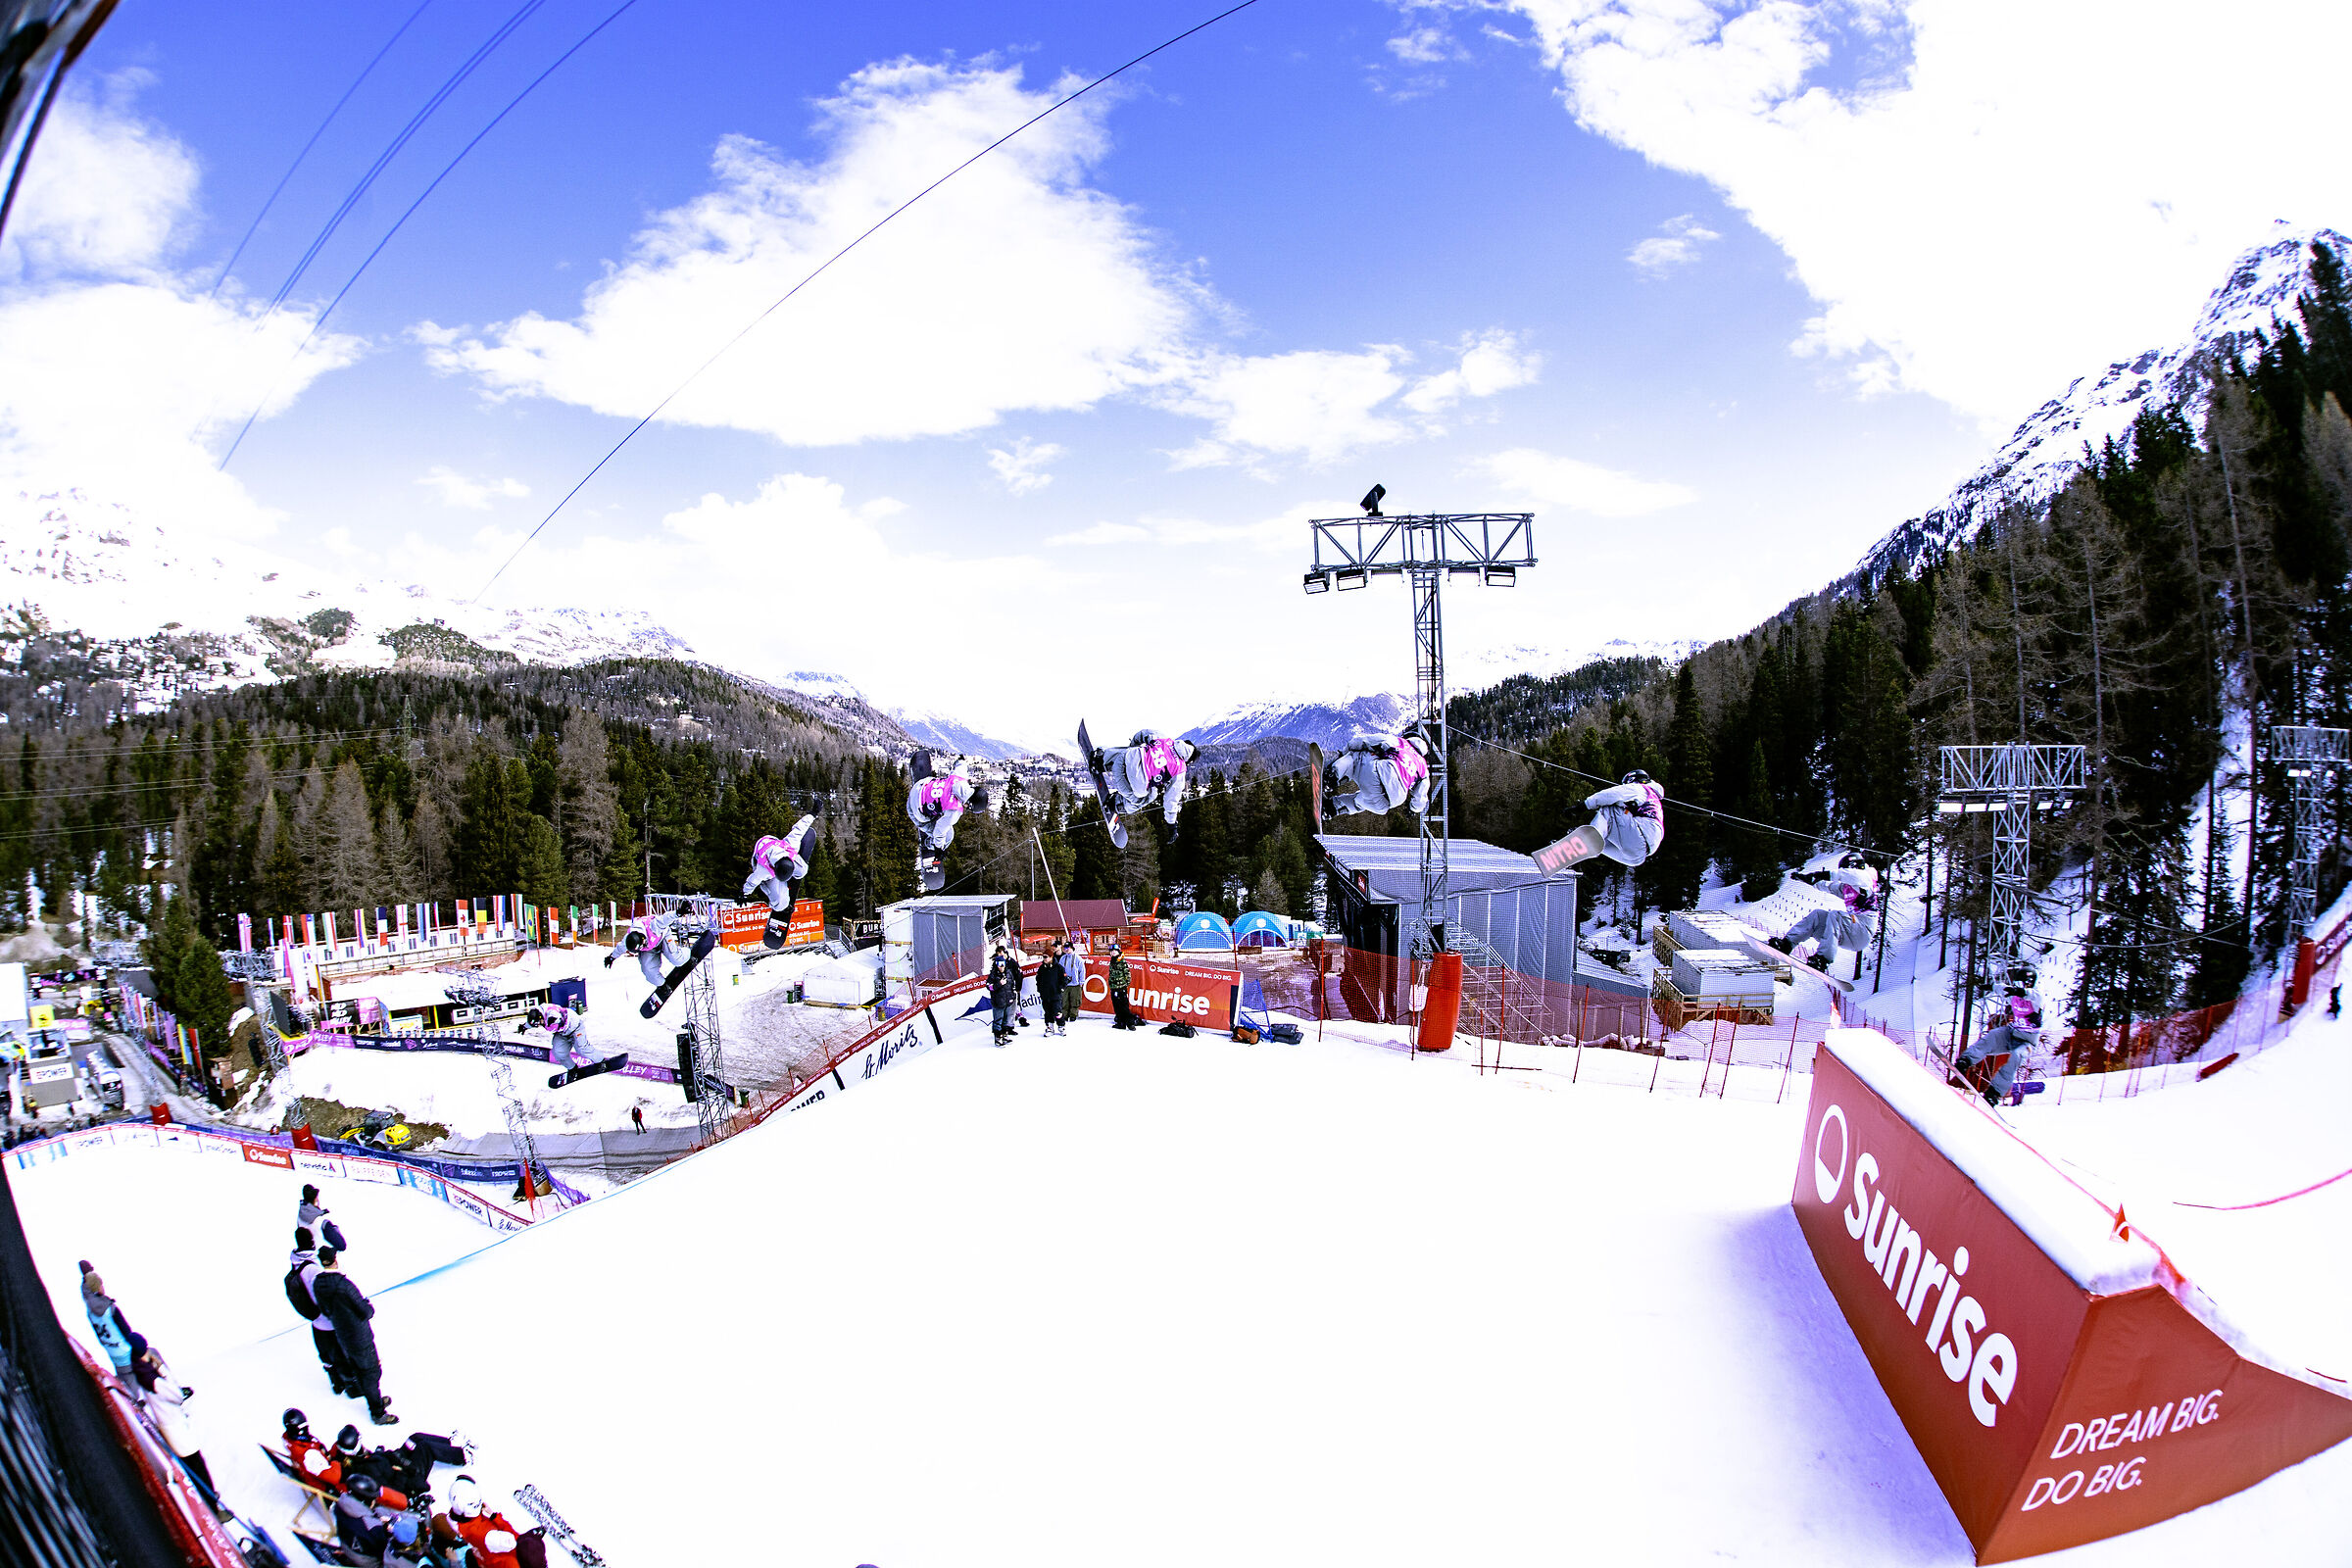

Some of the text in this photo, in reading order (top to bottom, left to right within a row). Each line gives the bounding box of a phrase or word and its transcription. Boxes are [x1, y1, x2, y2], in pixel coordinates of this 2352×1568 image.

[1540, 836, 1589, 872] NITRO
[796, 919, 820, 930] Sunrise
[1156, 965, 1179, 975] Sunrise
[1127, 987, 1210, 1016] unrise
[875, 1023, 918, 1076] Moritz
[1843, 1152, 2019, 1428] Sunrise
[2049, 1389, 2225, 1460] DREAM BIG.
[2021, 1456, 2148, 1512] DO BIG.
